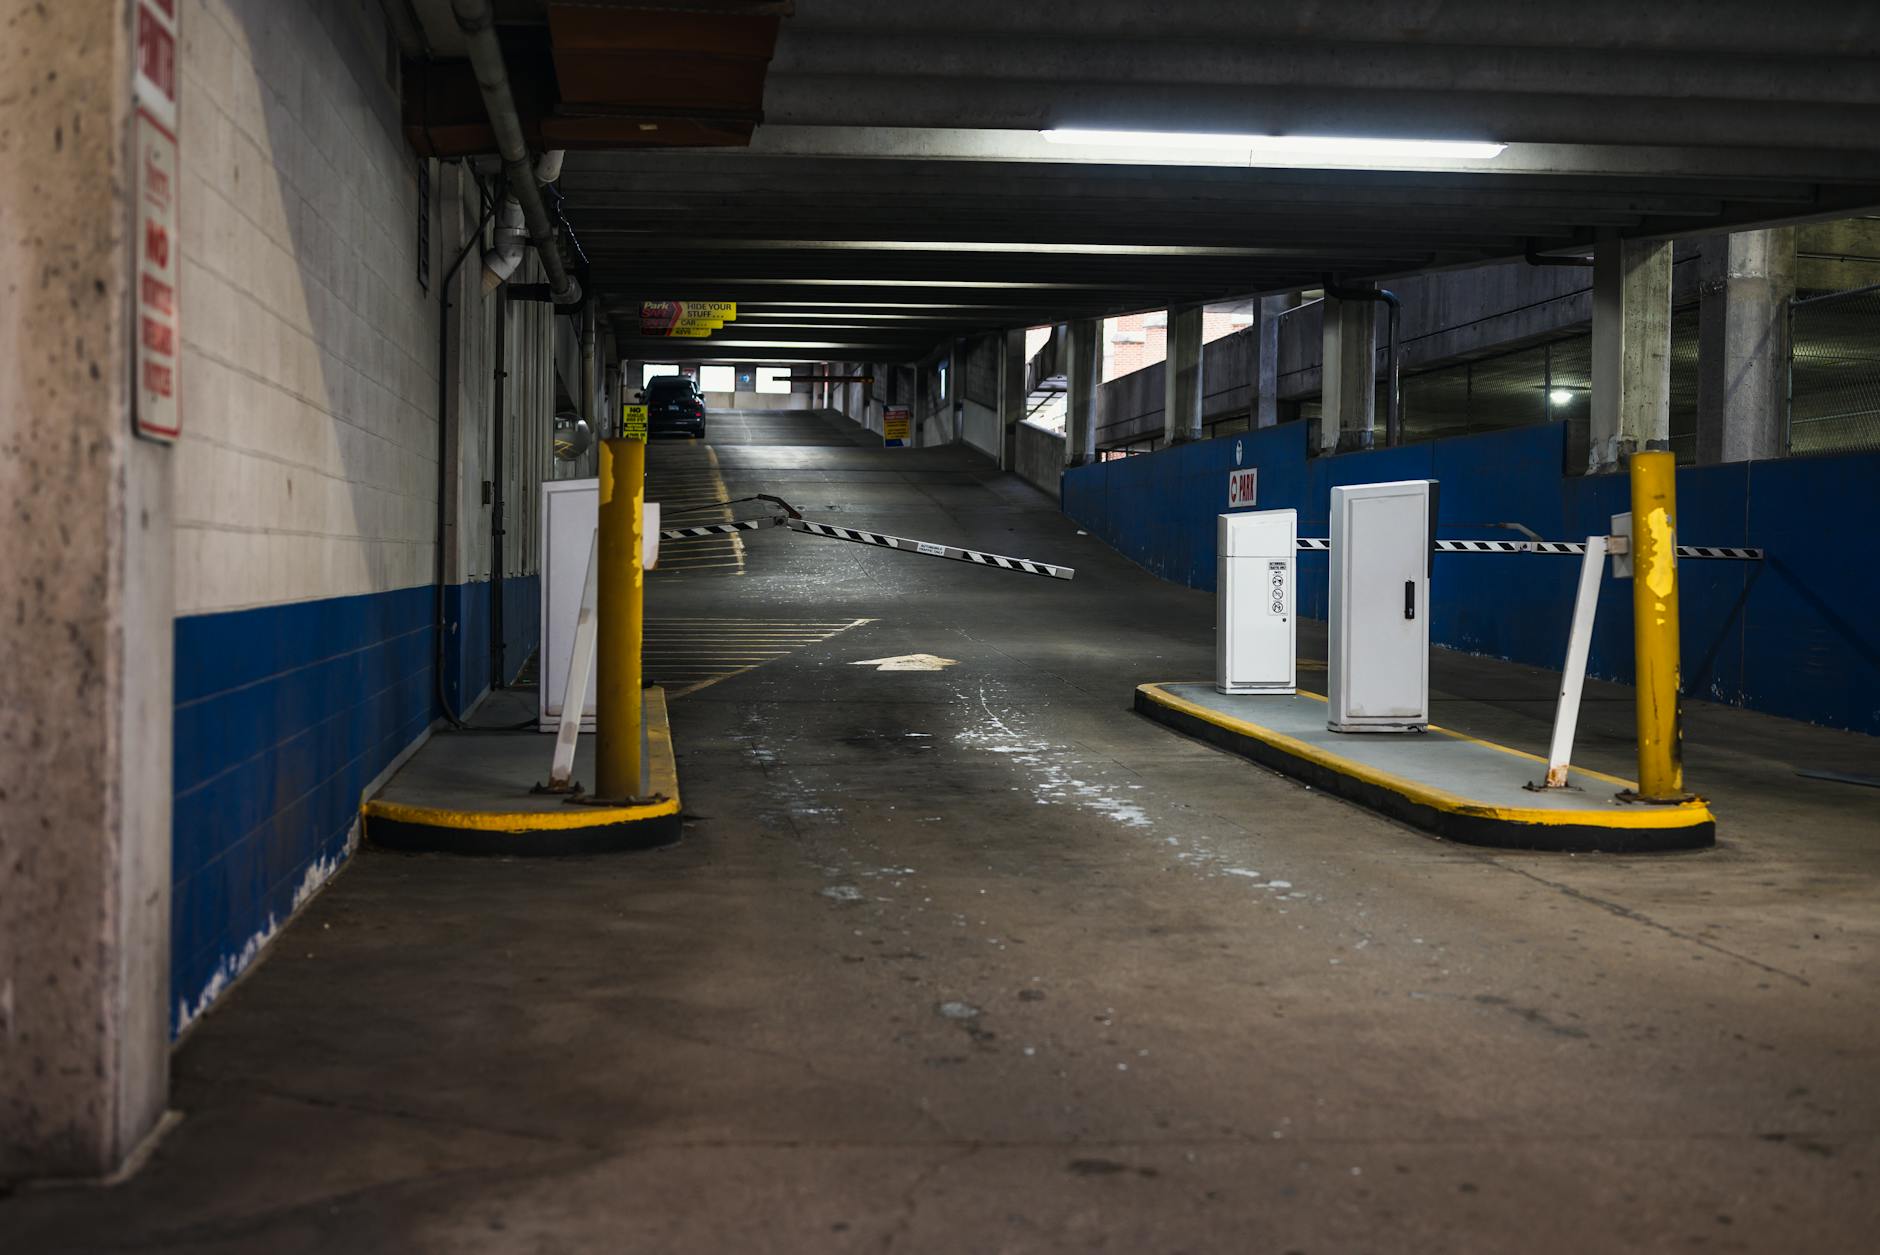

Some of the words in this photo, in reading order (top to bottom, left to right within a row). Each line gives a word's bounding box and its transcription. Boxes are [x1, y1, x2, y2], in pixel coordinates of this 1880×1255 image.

[644, 301, 669, 310] Park
[688, 303, 706, 311] HIDE
[709, 303, 732, 311] YOUR
[1240, 473, 1255, 502] PARK
